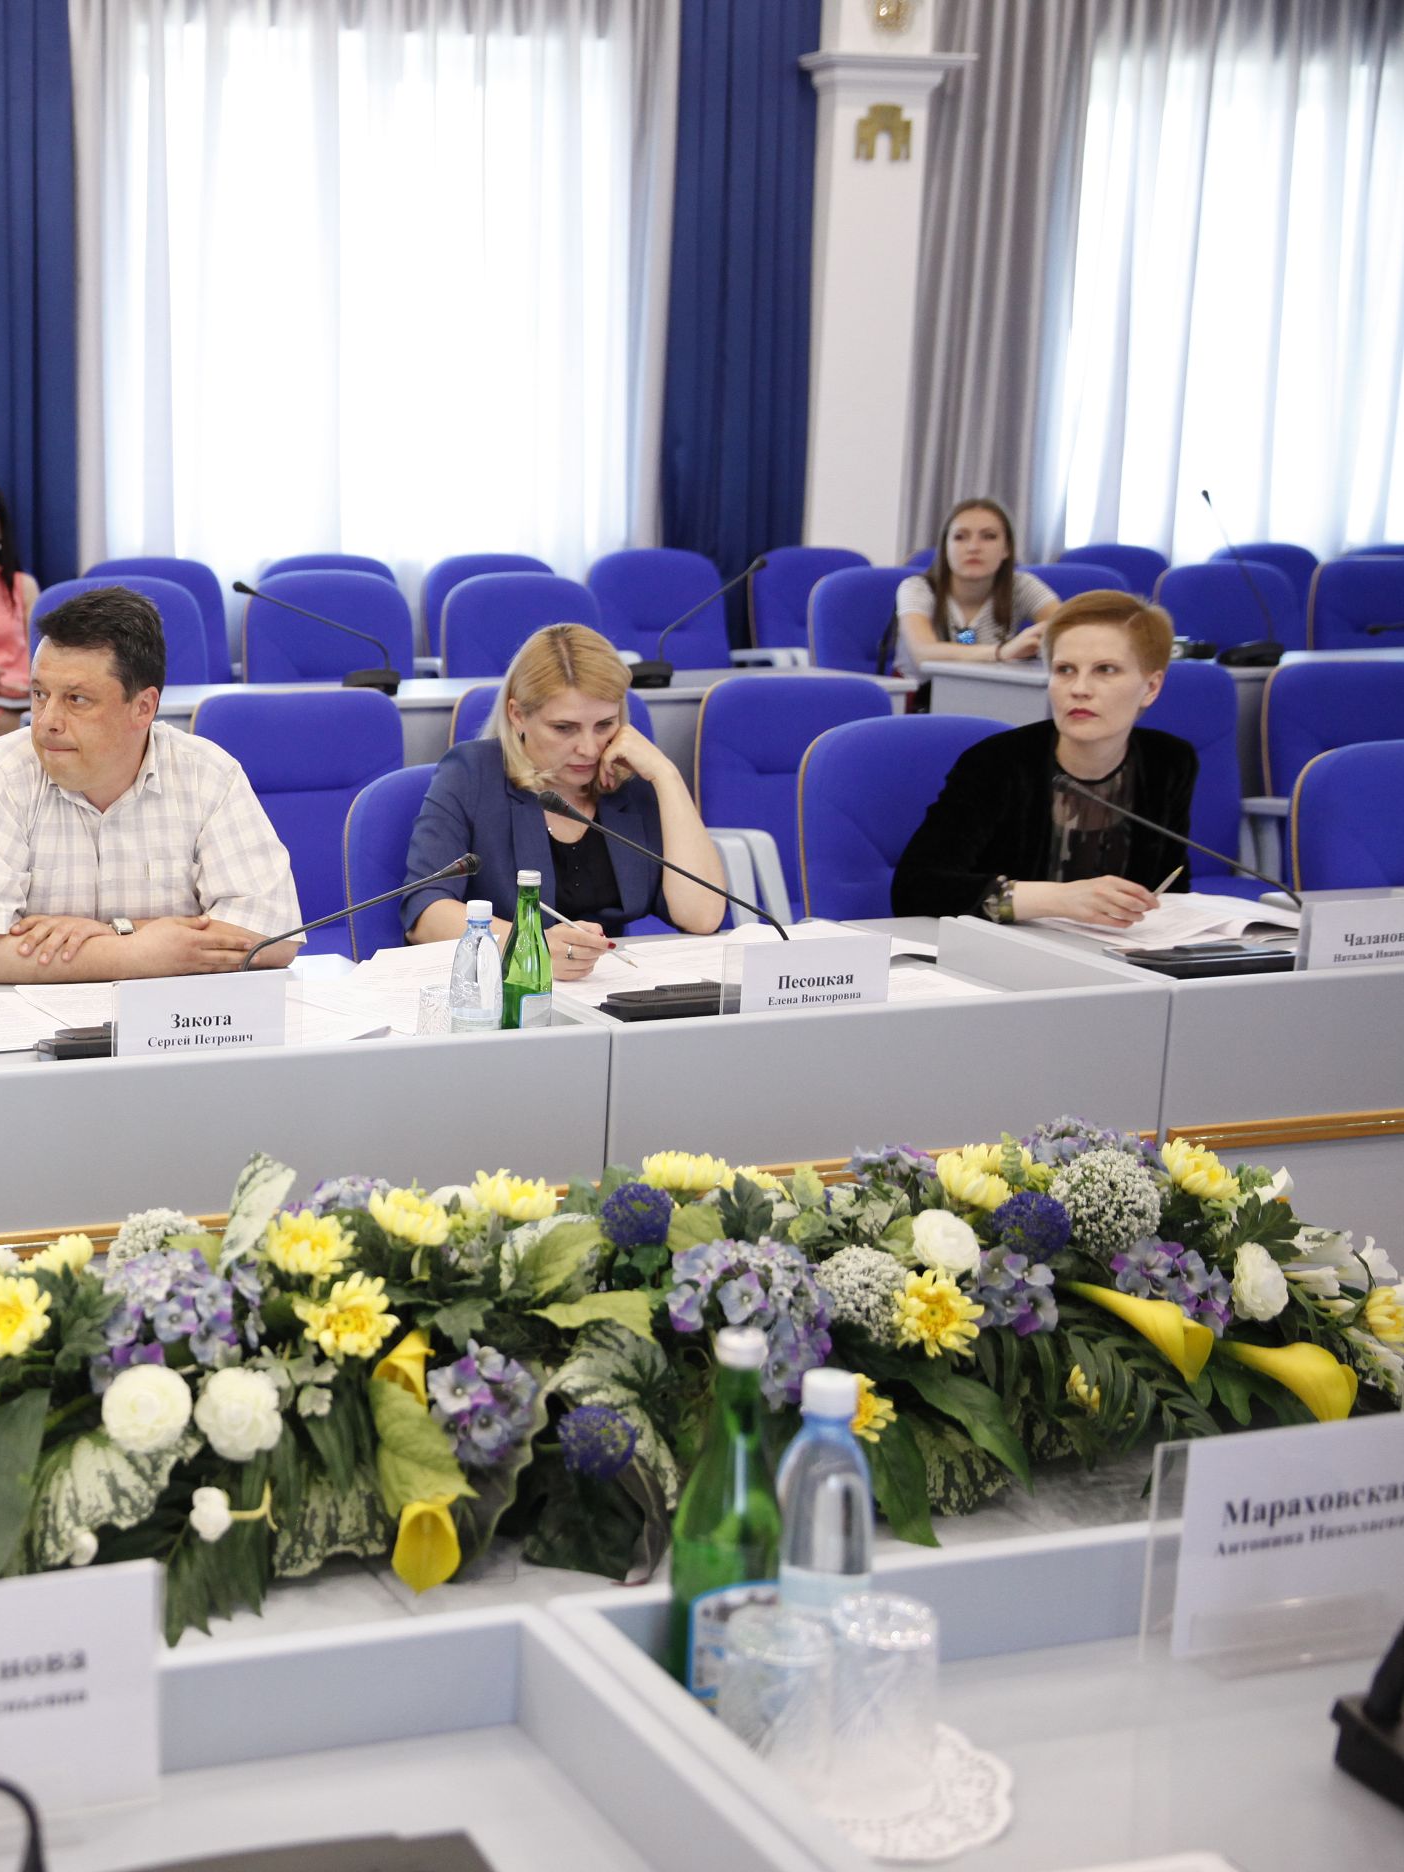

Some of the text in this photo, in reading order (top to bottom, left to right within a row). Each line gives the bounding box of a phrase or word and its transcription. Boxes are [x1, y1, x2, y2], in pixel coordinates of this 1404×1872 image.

[777, 972, 855, 991] Песоцкая
[768, 991, 861, 1006] Елена Викторовна
[170, 1013, 232, 1029] Закота
[147, 1032, 253, 1049] Сергей Петрович
[1222, 1481, 1404, 1529] Мараховска
[1216, 1531, 1304, 1557] Антонина
